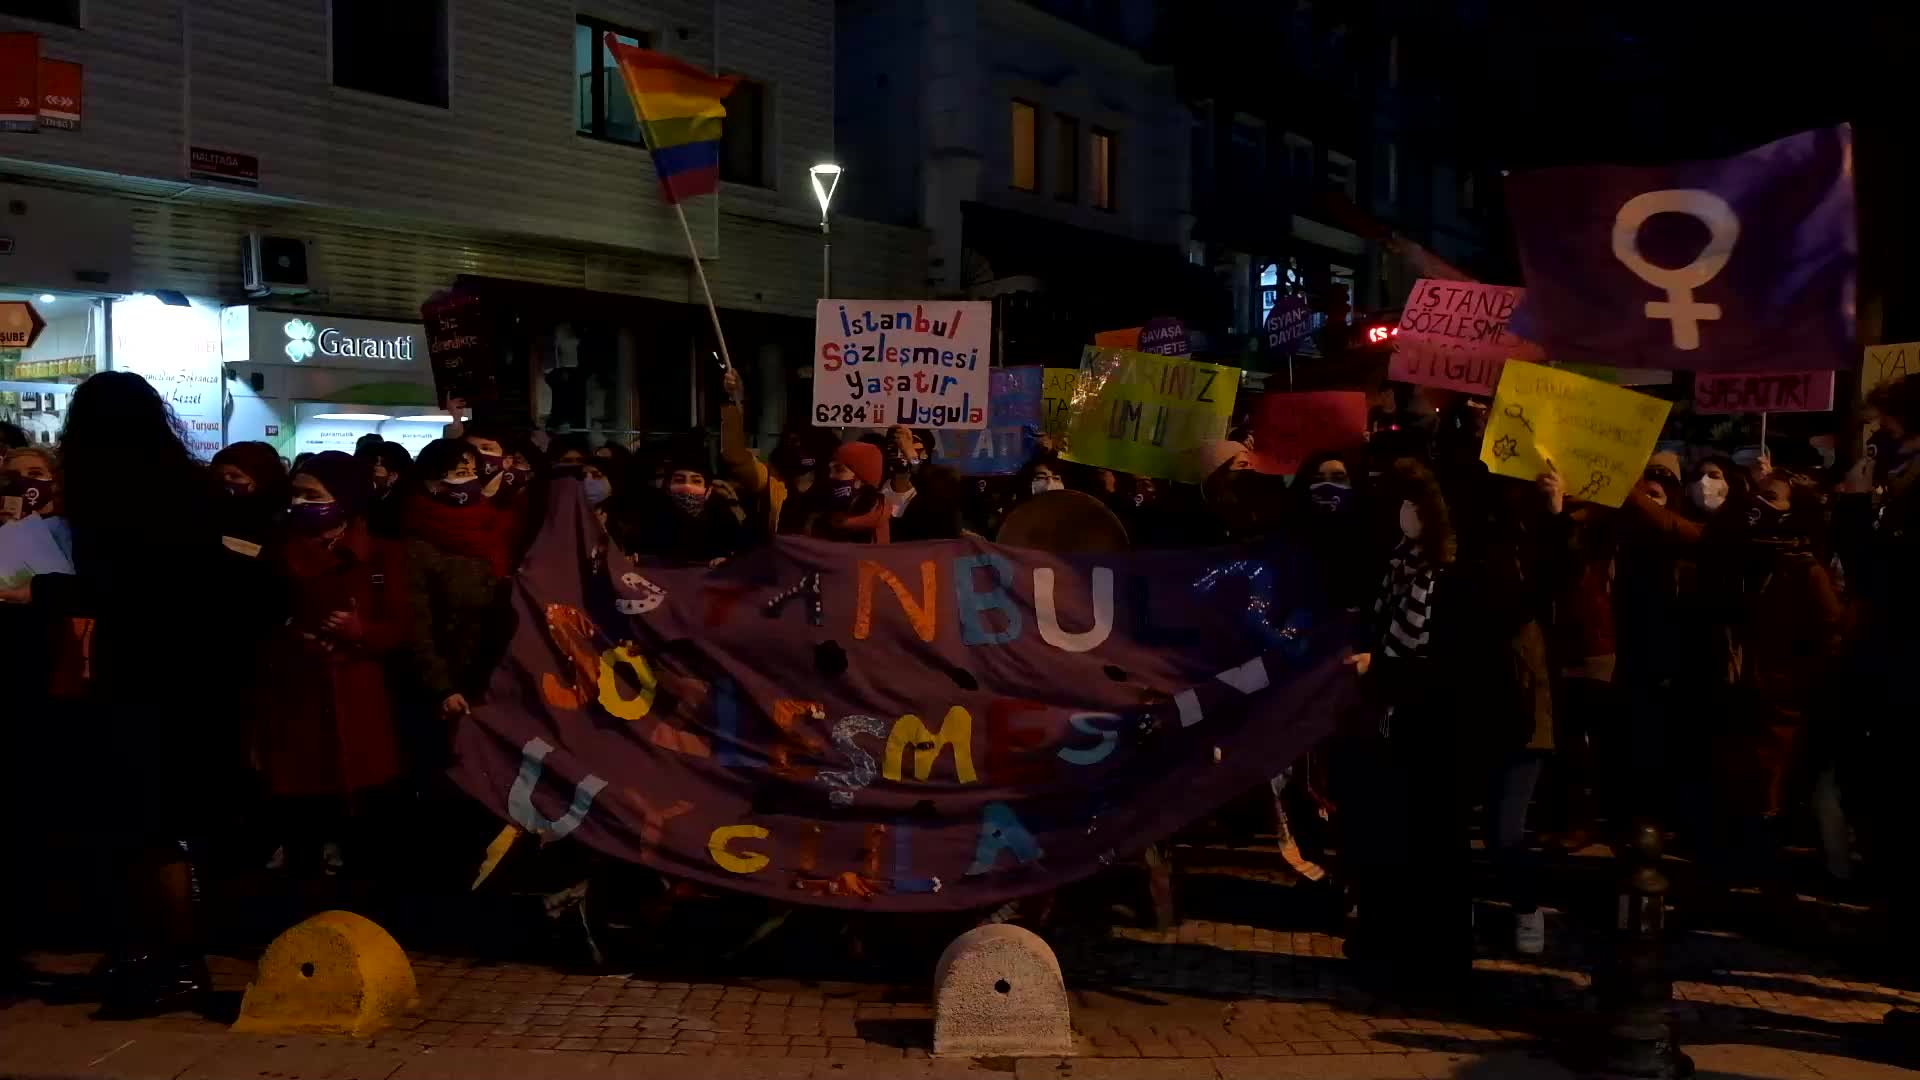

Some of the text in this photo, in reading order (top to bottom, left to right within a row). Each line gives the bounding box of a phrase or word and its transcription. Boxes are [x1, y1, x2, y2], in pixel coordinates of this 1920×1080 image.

[1415, 281, 1516, 321] İSTANB
[839, 304, 963, 339] İstanbul
[318, 327, 414, 361] Garanti
[822, 332, 979, 373] Sözleşmesi
